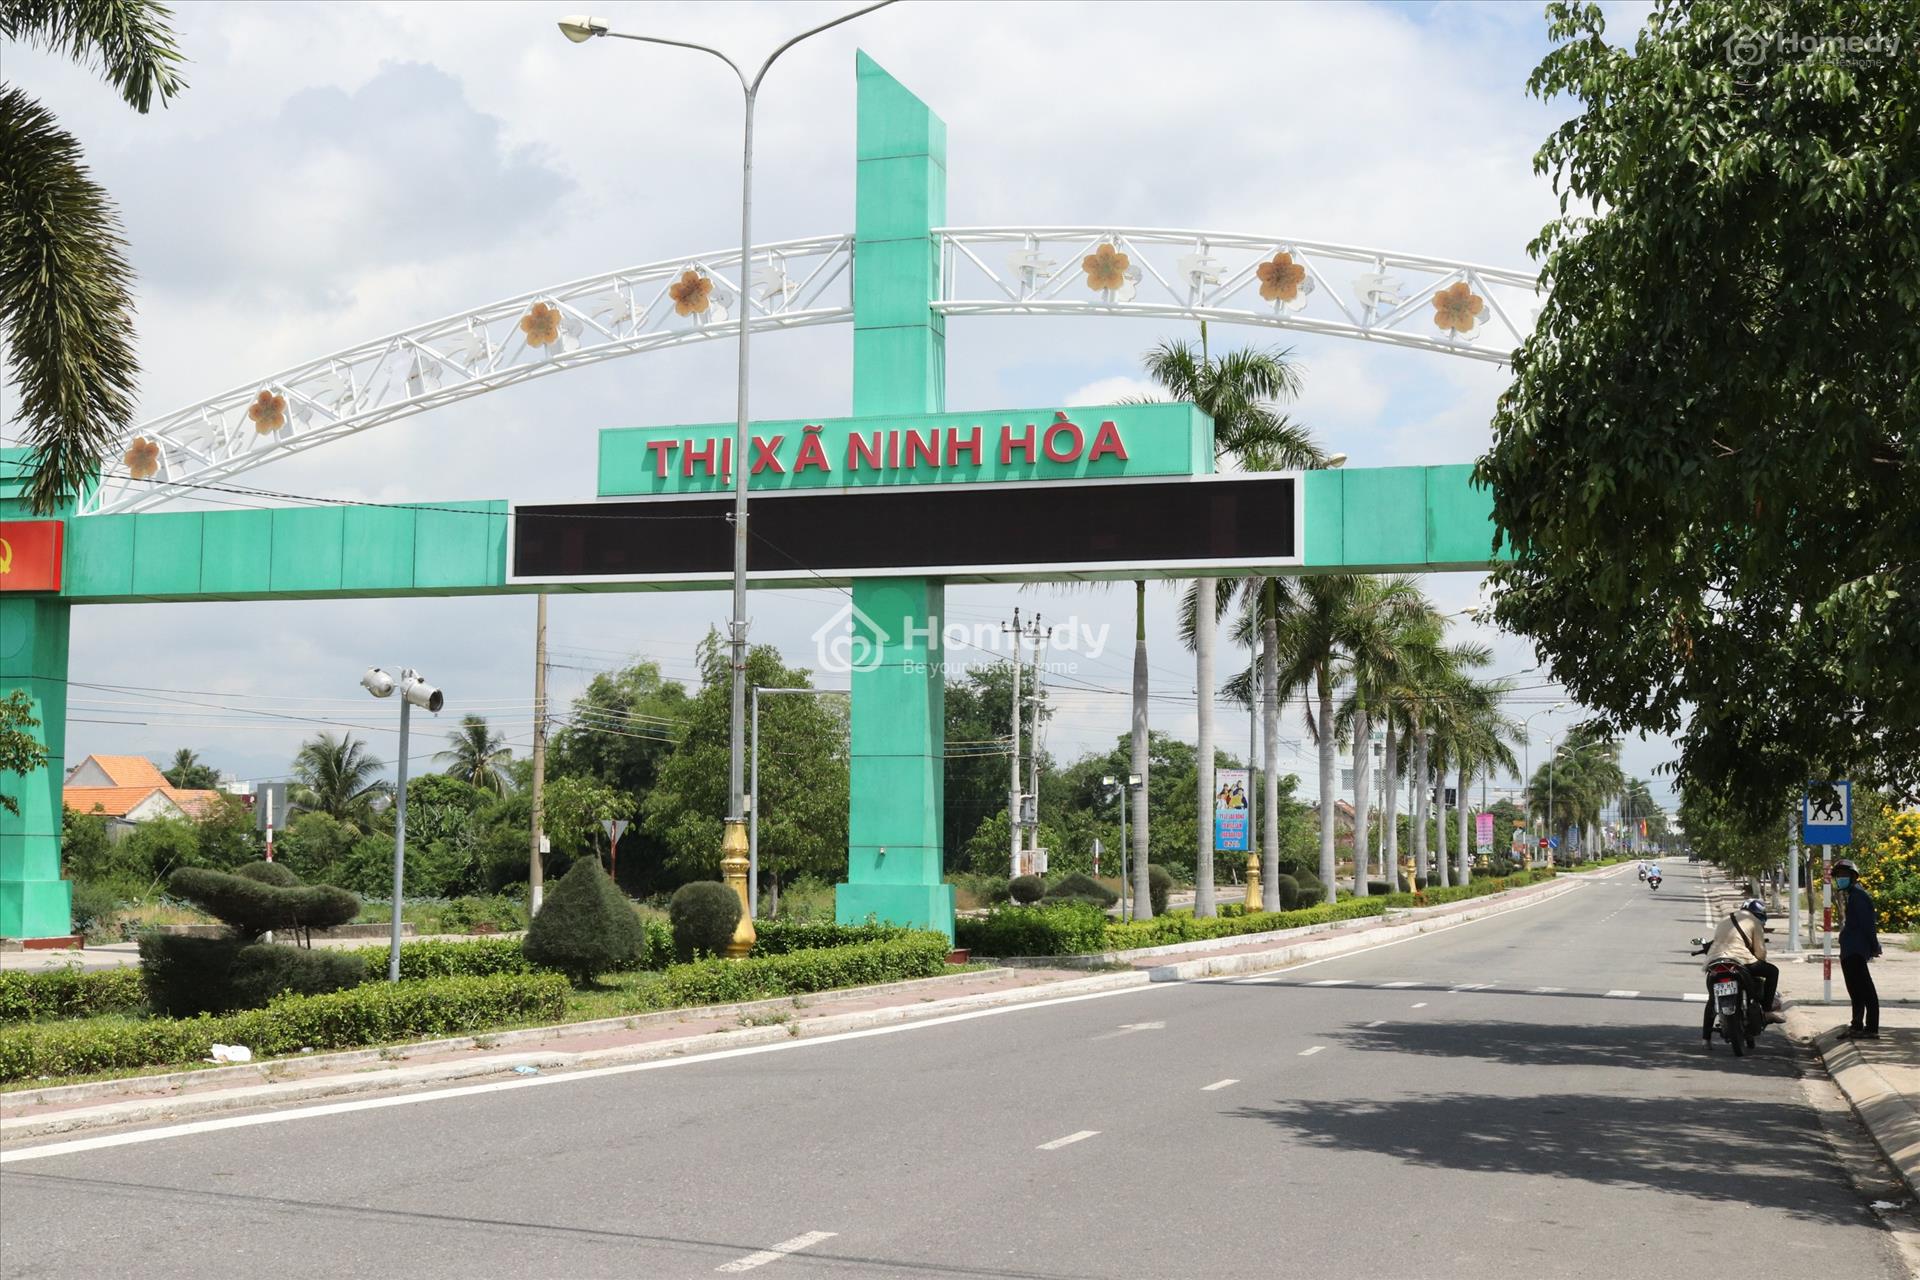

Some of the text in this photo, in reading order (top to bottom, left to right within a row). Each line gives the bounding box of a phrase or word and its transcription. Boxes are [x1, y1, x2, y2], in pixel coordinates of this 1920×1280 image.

[646, 411, 1129, 485] THỊ XÃ NINH HÒA
